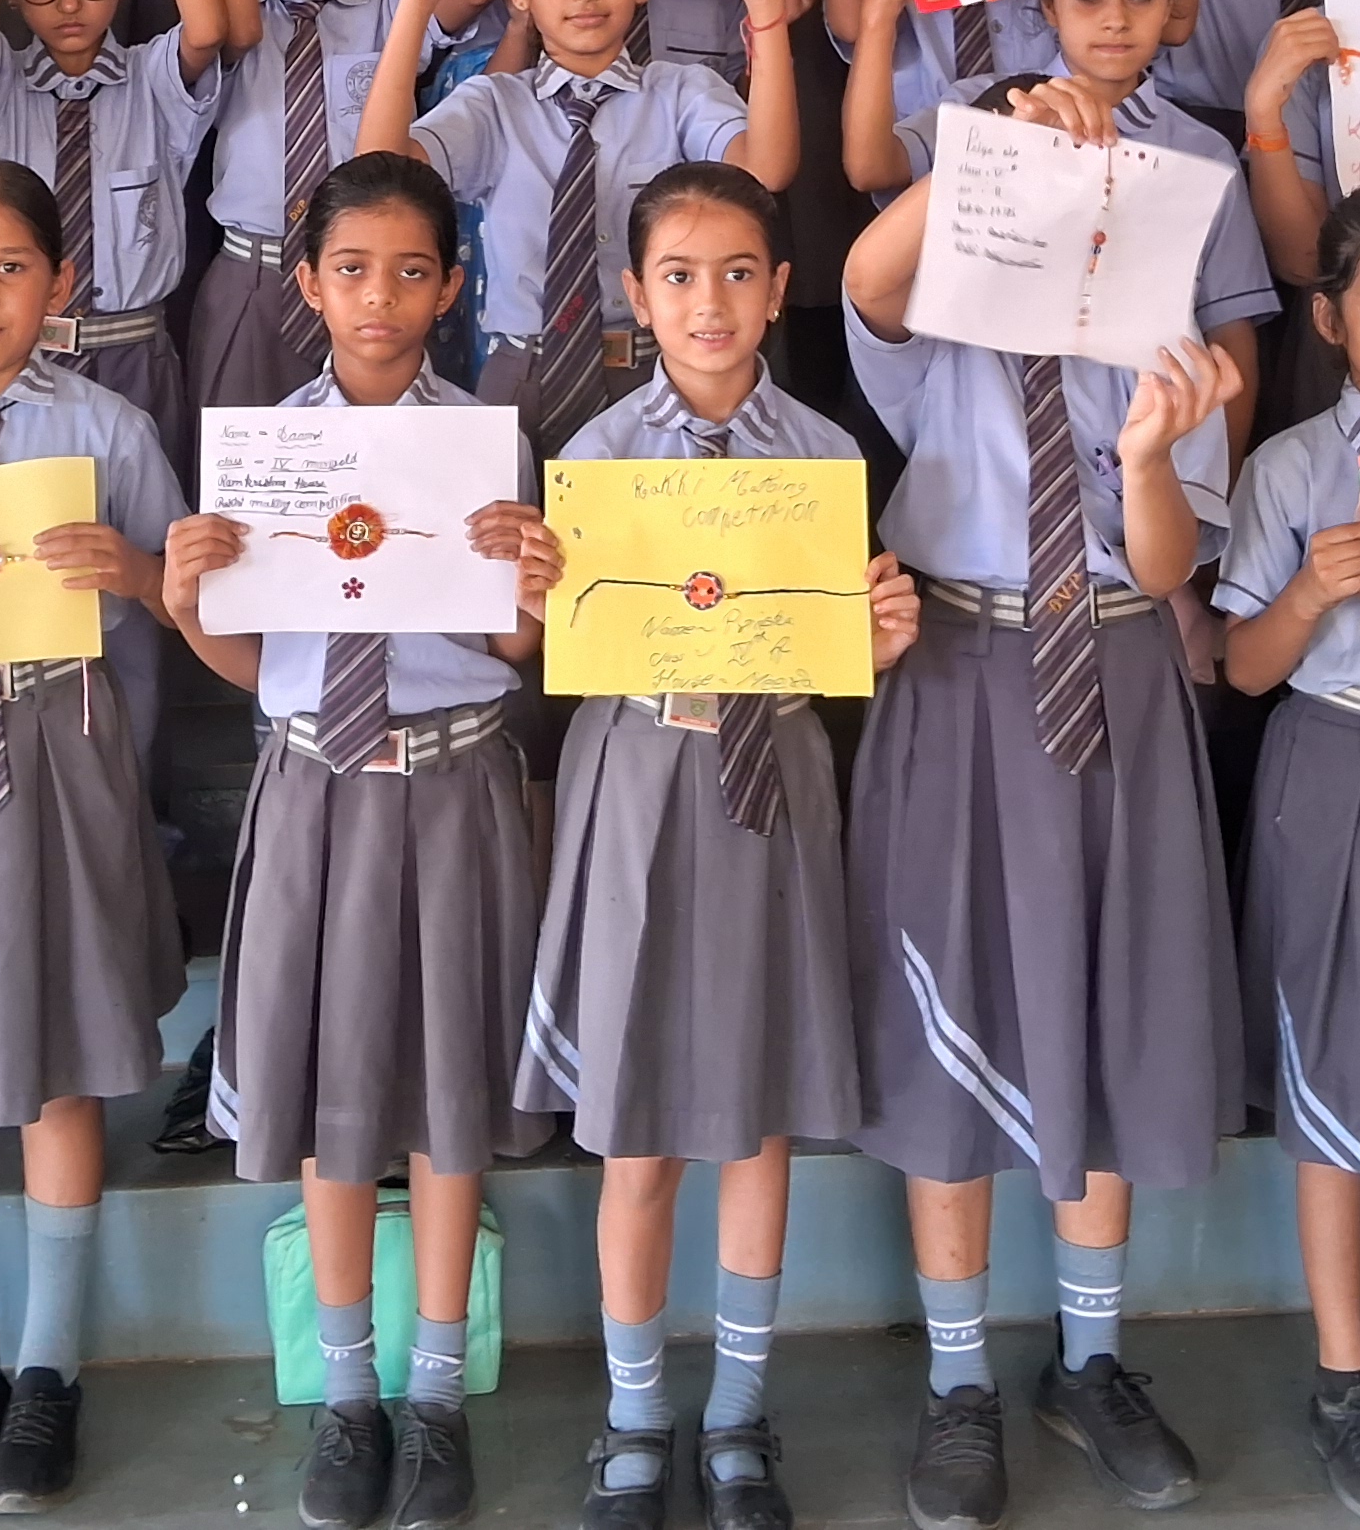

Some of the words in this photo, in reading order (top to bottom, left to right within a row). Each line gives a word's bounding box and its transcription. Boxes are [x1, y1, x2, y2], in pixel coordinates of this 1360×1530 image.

[288, 199, 308, 222] DVP
[220, 425, 251, 439] Name
[1076, 1294, 1122, 1309] DV
